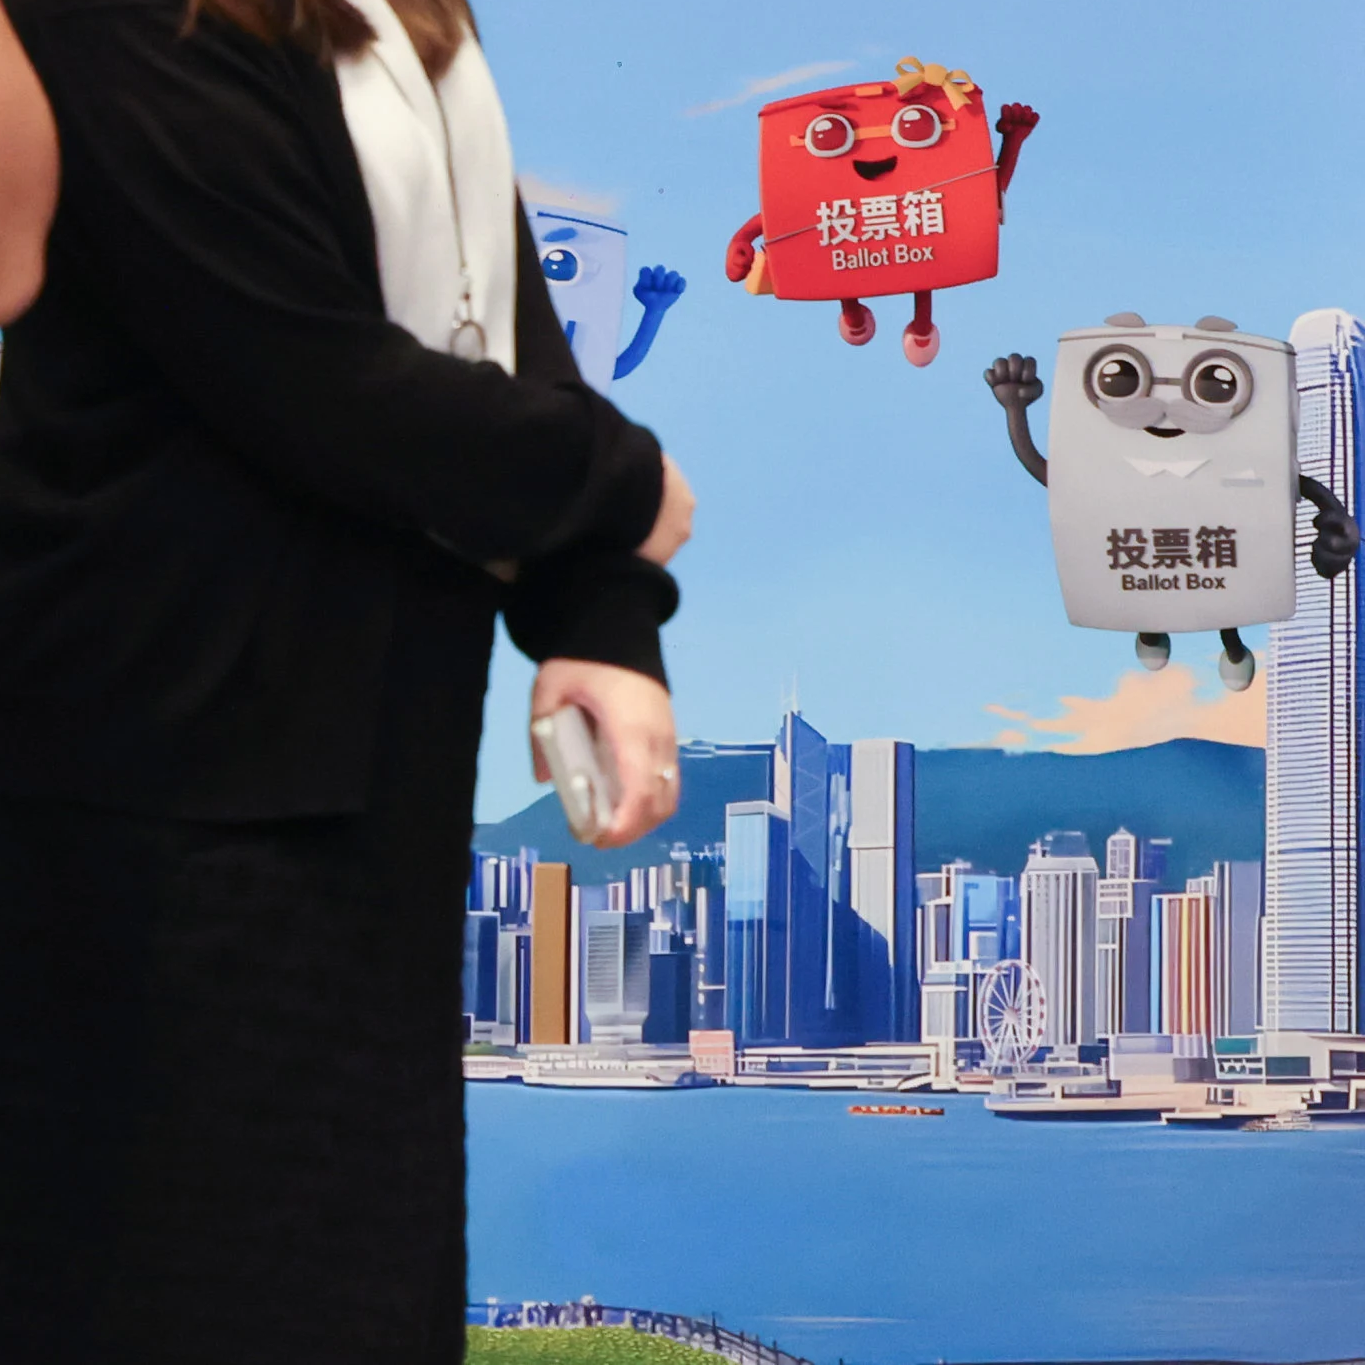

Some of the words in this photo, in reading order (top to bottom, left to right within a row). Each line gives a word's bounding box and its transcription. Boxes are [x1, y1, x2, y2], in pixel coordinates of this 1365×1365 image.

[816, 189, 944, 246] 投票箱
[832, 248, 889, 270] Ballot
[894, 244, 933, 263] Box
[1106, 525, 1238, 571] 投票箱
[1121, 573, 1181, 591] Ballot
[1185, 572, 1227, 591] Box
